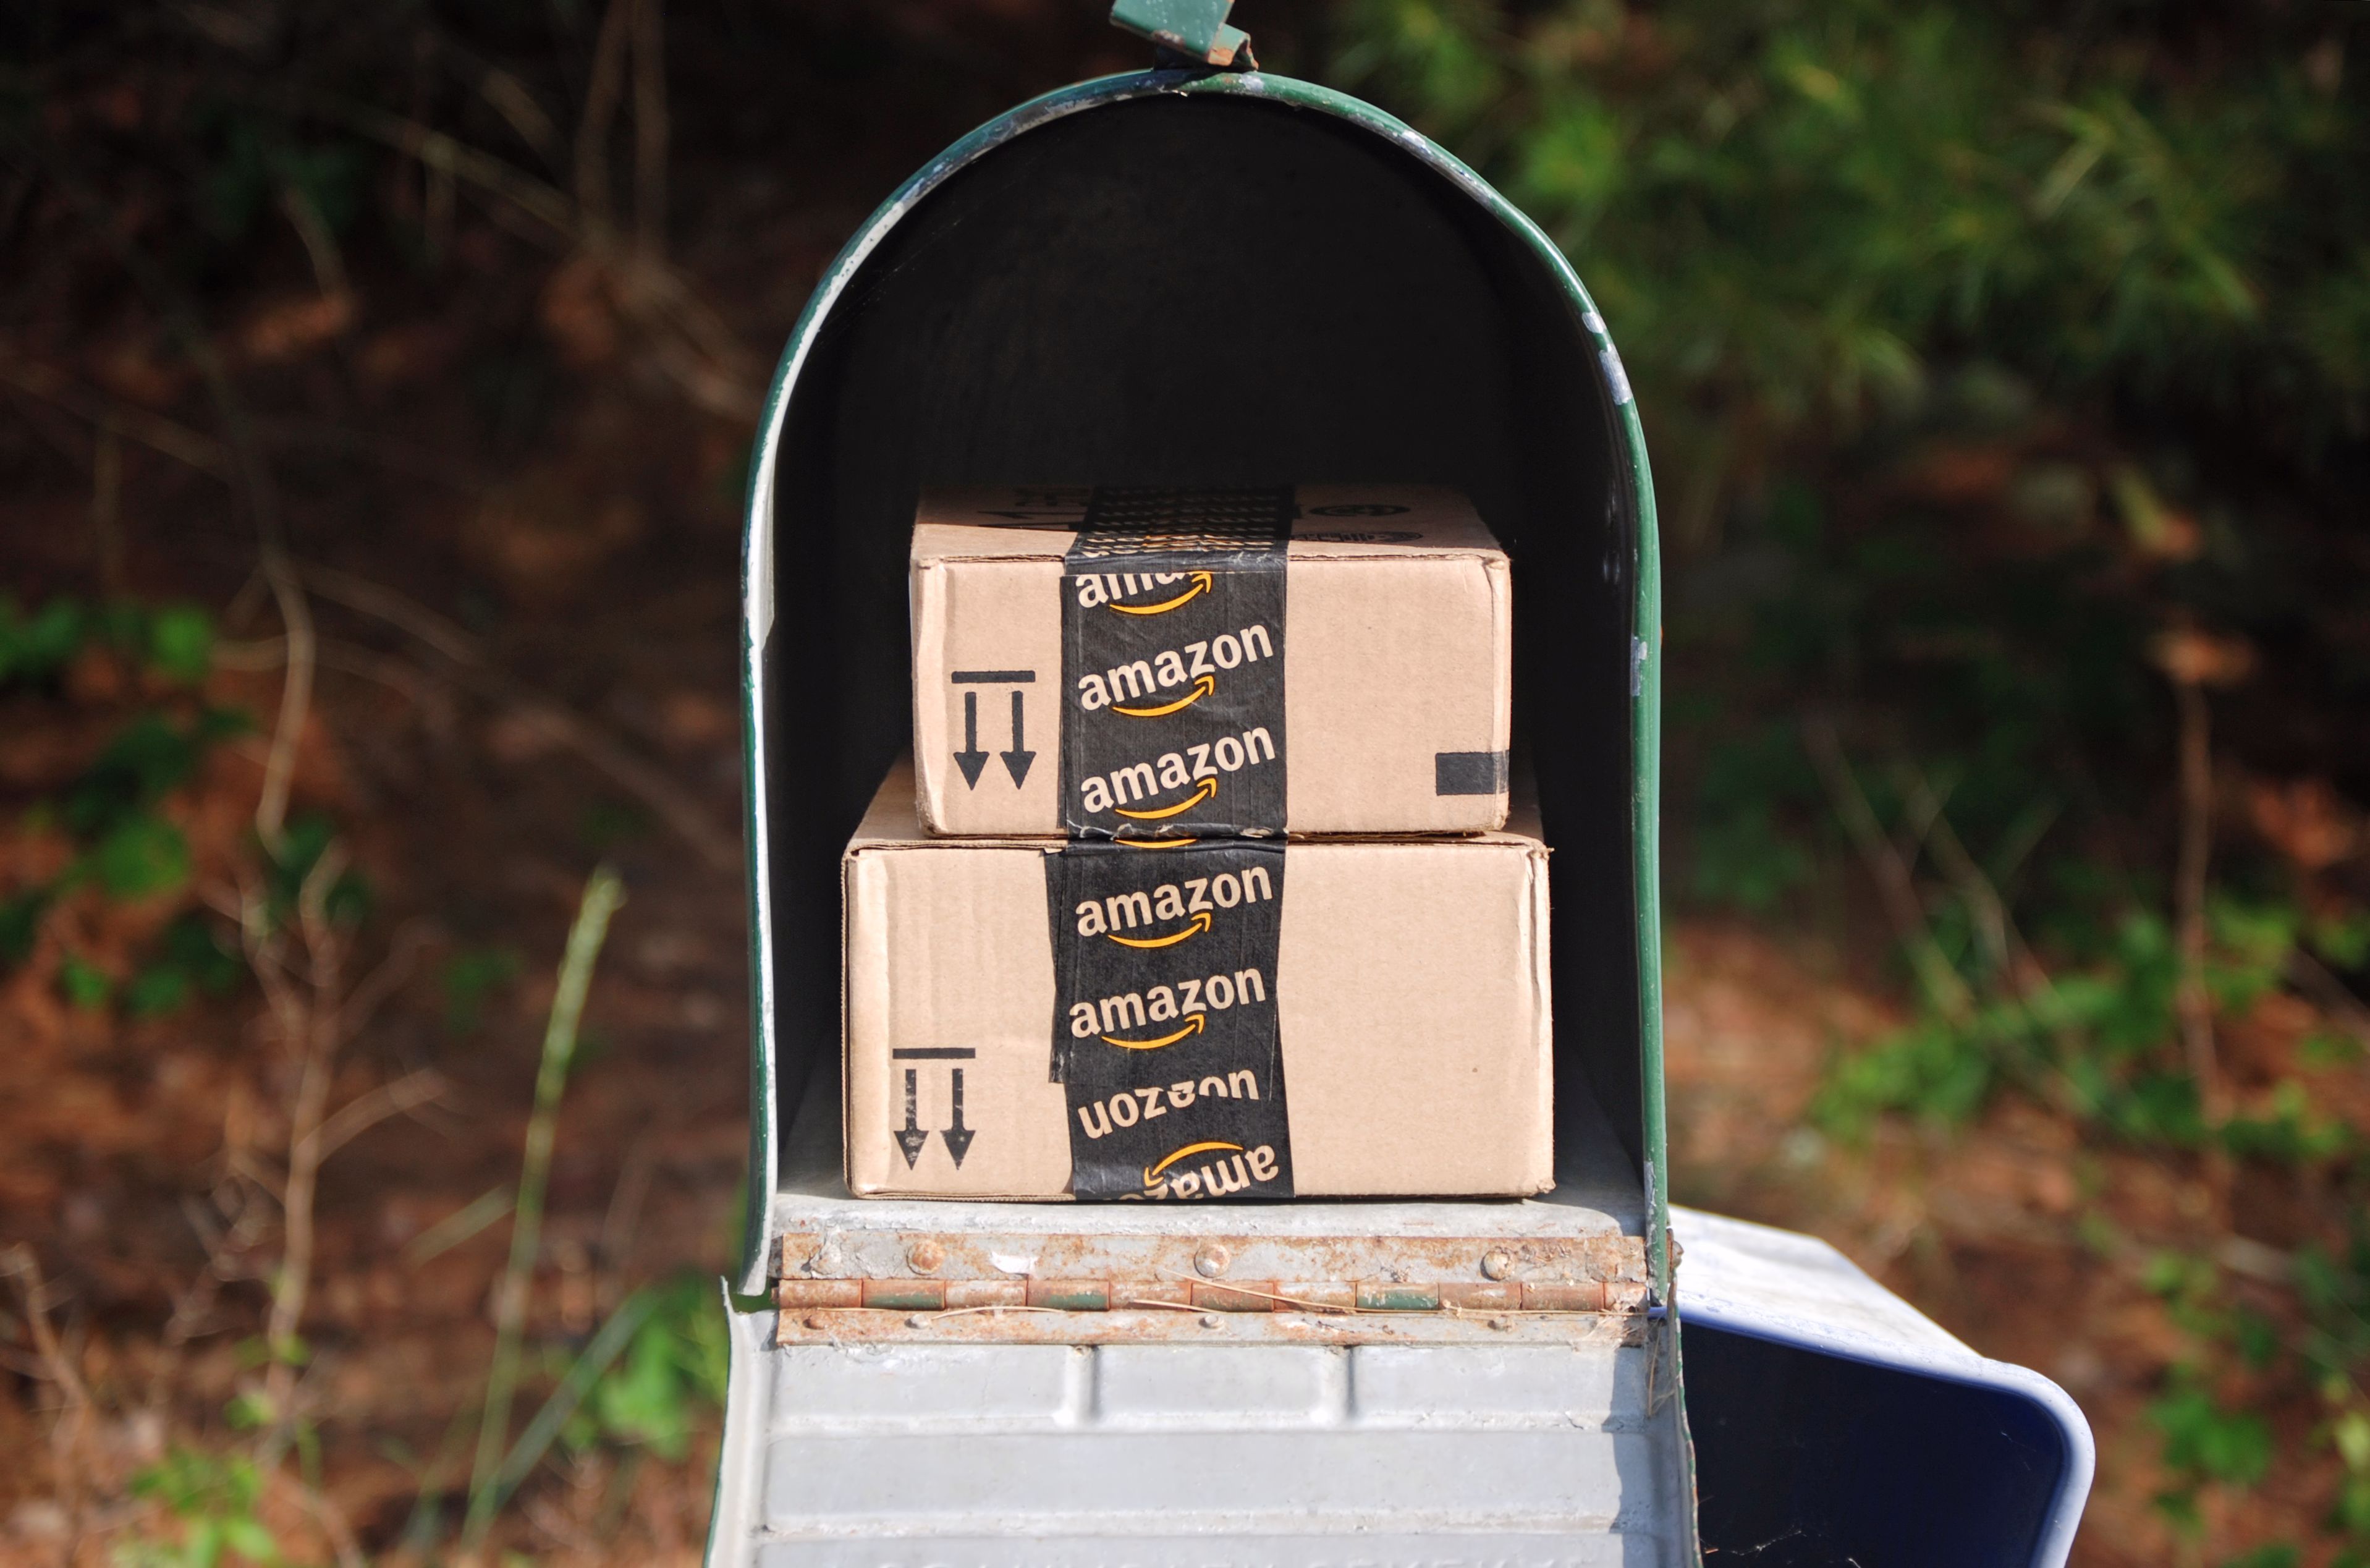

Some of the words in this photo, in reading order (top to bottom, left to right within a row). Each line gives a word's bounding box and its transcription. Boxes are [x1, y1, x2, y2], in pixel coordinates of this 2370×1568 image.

[1078, 625, 1274, 711] amazon
[1081, 727, 1276, 813] amazon
[1076, 867, 1273, 937] amazon
[1070, 968, 1266, 1038] amazon
